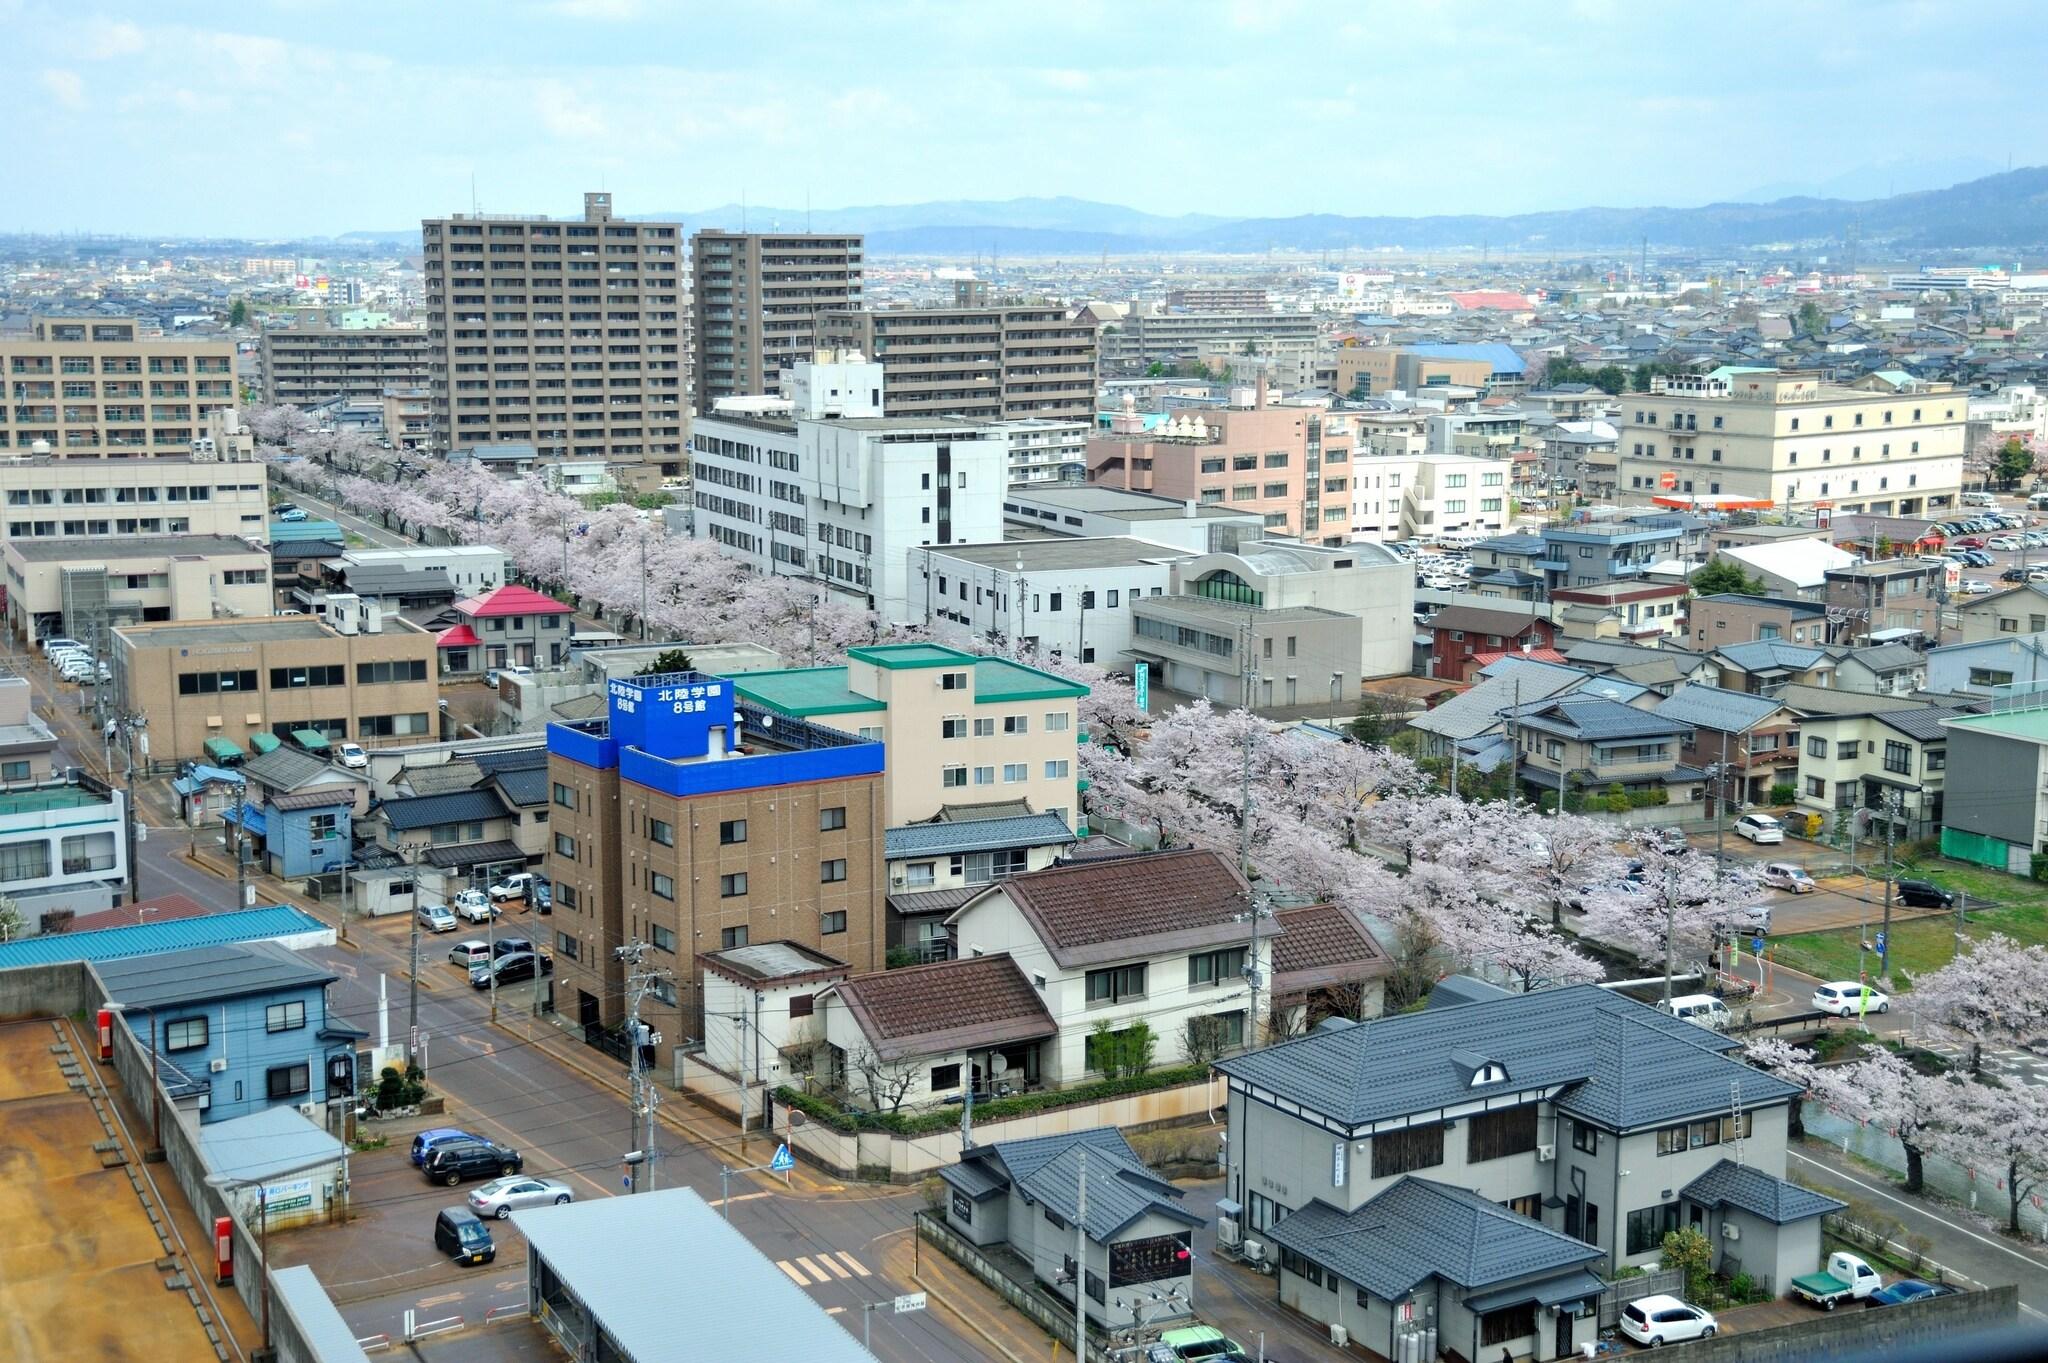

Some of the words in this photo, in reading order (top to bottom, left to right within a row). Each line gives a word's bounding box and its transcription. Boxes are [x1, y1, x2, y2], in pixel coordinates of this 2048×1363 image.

[610, 683, 642, 702] 北陸学園
[658, 685, 721, 701] 北陸学園
[617, 698, 635, 713] 8号館
[673, 700, 706, 713] 8号館
